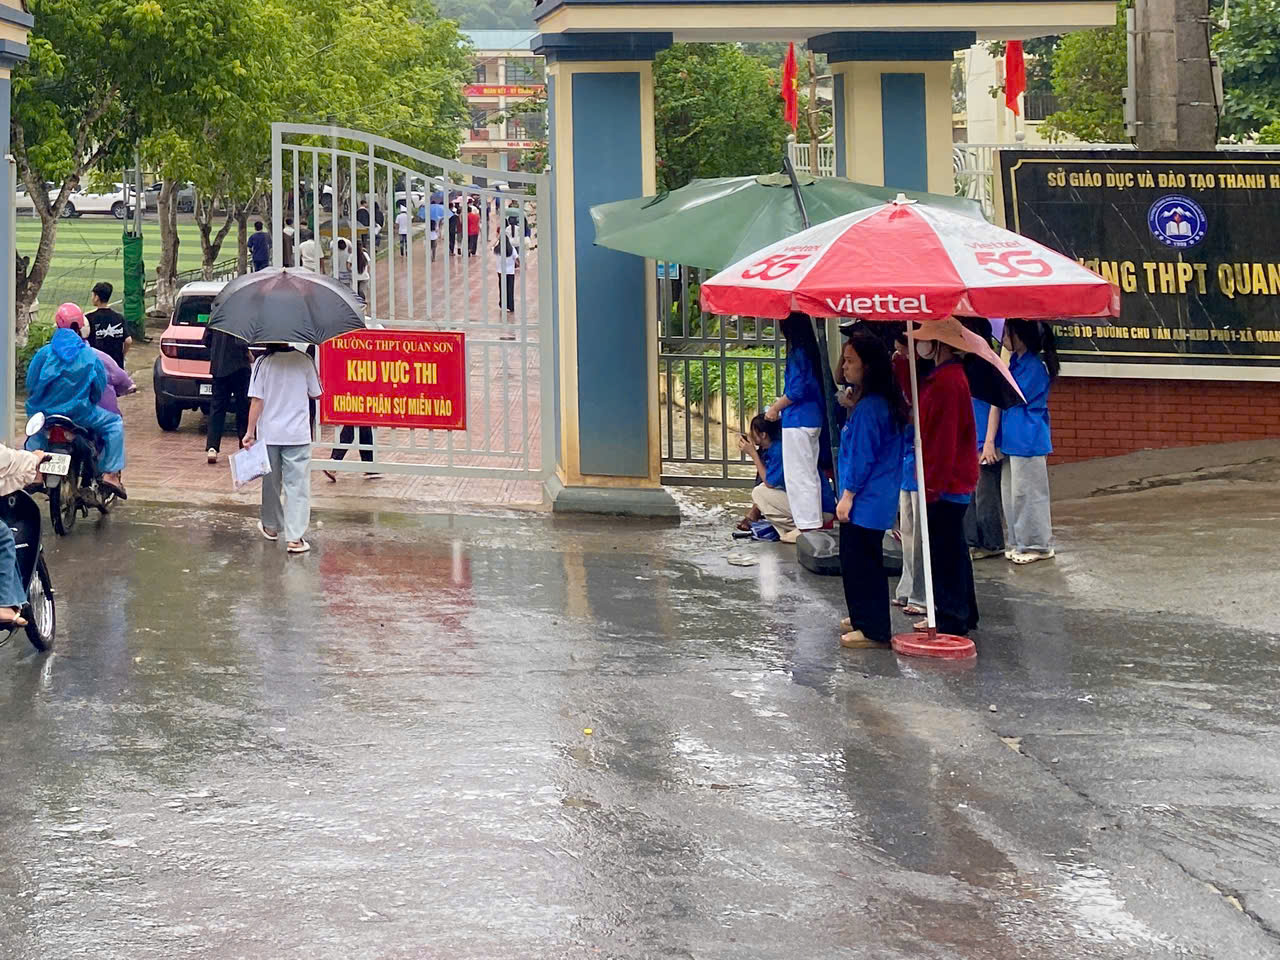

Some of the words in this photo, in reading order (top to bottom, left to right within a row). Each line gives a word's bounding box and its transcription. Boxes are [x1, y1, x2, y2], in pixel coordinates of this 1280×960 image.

[1047, 167, 1065, 186] SỞ
[1070, 170, 1102, 187] GIÁO
[1106, 172, 1134, 190] DỤC
[1137, 170, 1155, 188] VÀ
[1158, 170, 1186, 188] ĐÀO
[1189, 174, 1215, 191] TẠO
[1218, 174, 1266, 189] THANH
[741, 254, 811, 280] 5G
[974, 250, 1053, 277] 5G
[1143, 261, 1207, 294] THPT
[1218, 262, 1280, 299] QUAN
[826, 293, 932, 314] viettel
[332, 337, 373, 350] TRƯỜNG
[376, 340, 400, 351] THPT
[403, 341, 431, 353] QUAN
[433, 342, 454, 352] SƠN
[1131, 327, 1149, 339] CHU
[347, 360, 377, 381] KHU
[381, 360, 410, 388] VỰC
[413, 362, 437, 384] THI
[333, 392, 364, 413] KHÔNG
[366, 393, 391, 417] PHẬN
[393, 396, 407, 418] SỰ
[434, 396, 452, 416] VÀO
